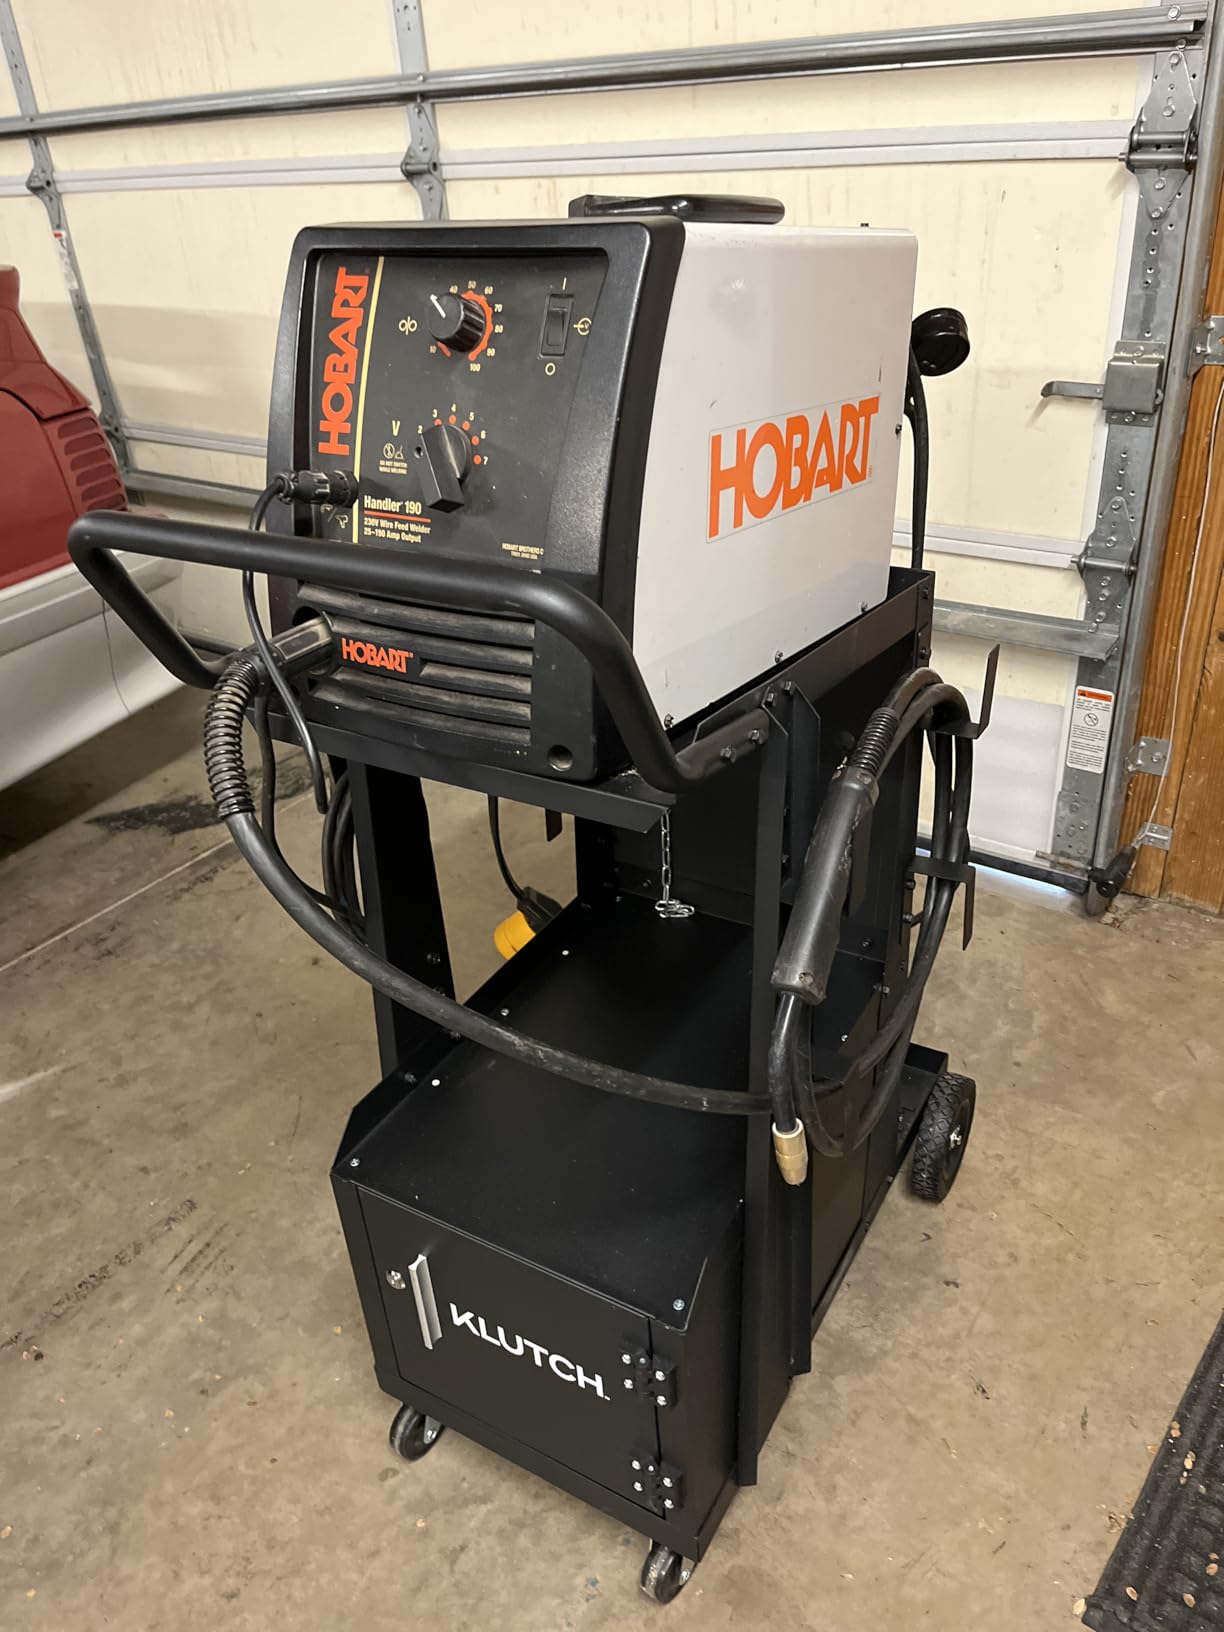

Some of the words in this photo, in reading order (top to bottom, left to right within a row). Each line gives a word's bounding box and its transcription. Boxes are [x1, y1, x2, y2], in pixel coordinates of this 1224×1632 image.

[449, 285, 458, 294] 40
[494, 303, 503, 312] 70
[494, 325, 504, 333] 80
[486, 348, 495, 357] 90
[318, 266, 369, 456] HOBART
[469, 363, 481, 372] 100
[451, 404, 456, 413] 4
[432, 409, 438, 418] 3
[469, 412, 475, 420] 5
[391, 420, 401, 437] V
[417, 425, 423, 434] 2
[480, 430, 486, 439] 6
[483, 456, 489, 465] 7
[709, 396, 880, 539] HOBART
[363, 495, 402, 512] Handler
[404, 501, 422, 515] 190
[363, 517, 379, 527] 230V
[380, 519, 393, 529] Wire
[394, 521, 409, 531] Feed
[410, 524, 431, 534] Welder
[386, 530, 400, 541] Amp
[401, 532, 422, 543] Output
[341, 637, 409, 674] HOBART
[449, 1302, 606, 1399] KLUTCH
